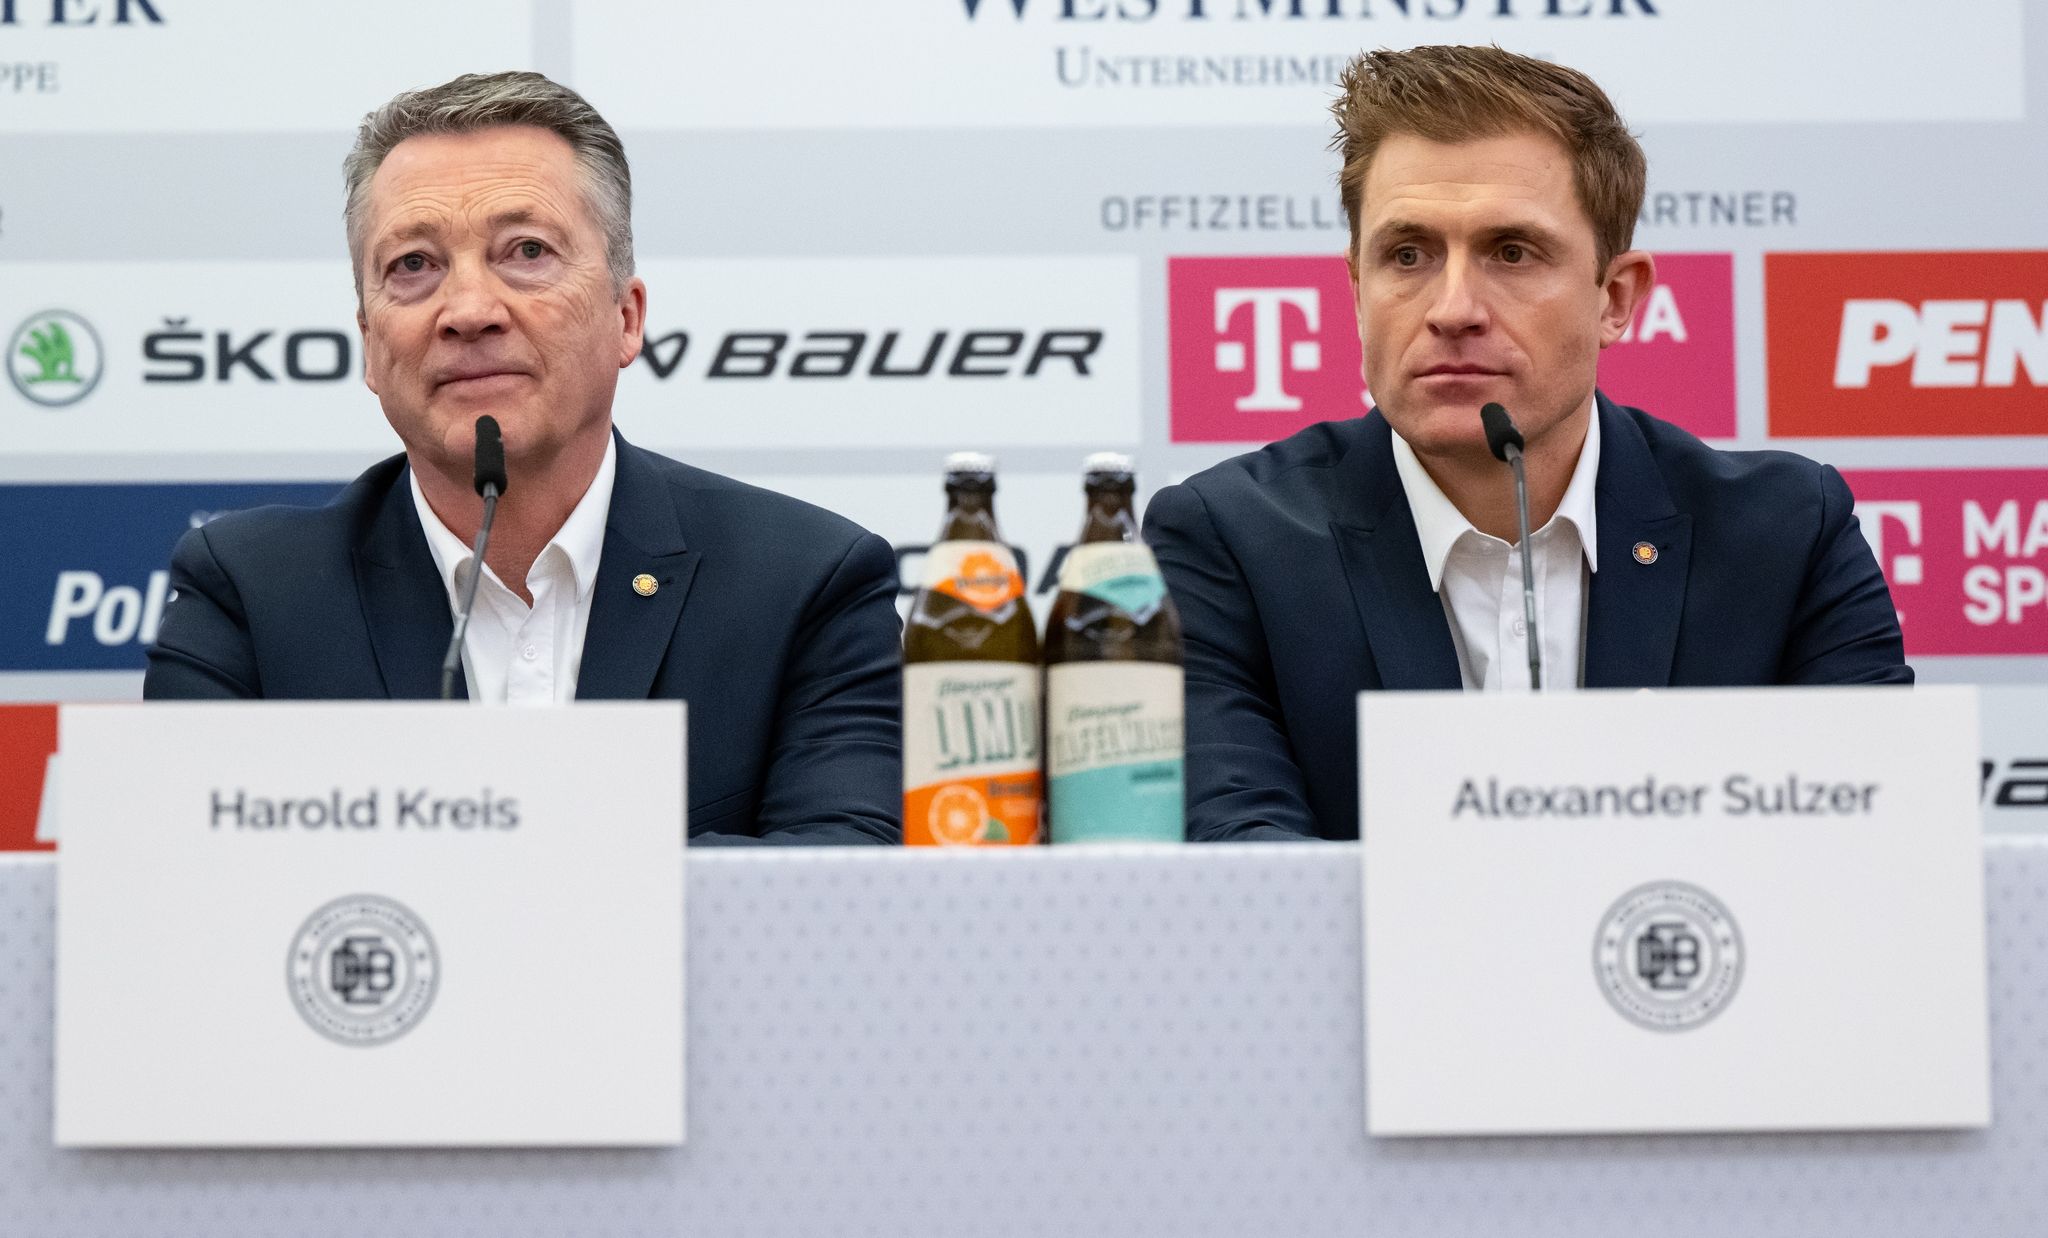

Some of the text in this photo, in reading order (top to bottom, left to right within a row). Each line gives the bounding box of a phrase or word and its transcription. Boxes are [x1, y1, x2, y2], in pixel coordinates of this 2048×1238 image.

[1101, 196, 1348, 230] OFFIZIELL
[1640, 191, 1798, 226] RTNER
[142, 317, 365, 383] ŠKO
[1834, 299, 2048, 388] PEN
[46, 570, 178, 645] Pol
[1963, 566, 2048, 625] SP
[210, 788, 520, 829] Harold Kreis
[1452, 774, 1880, 818] Alexander Sulzer
